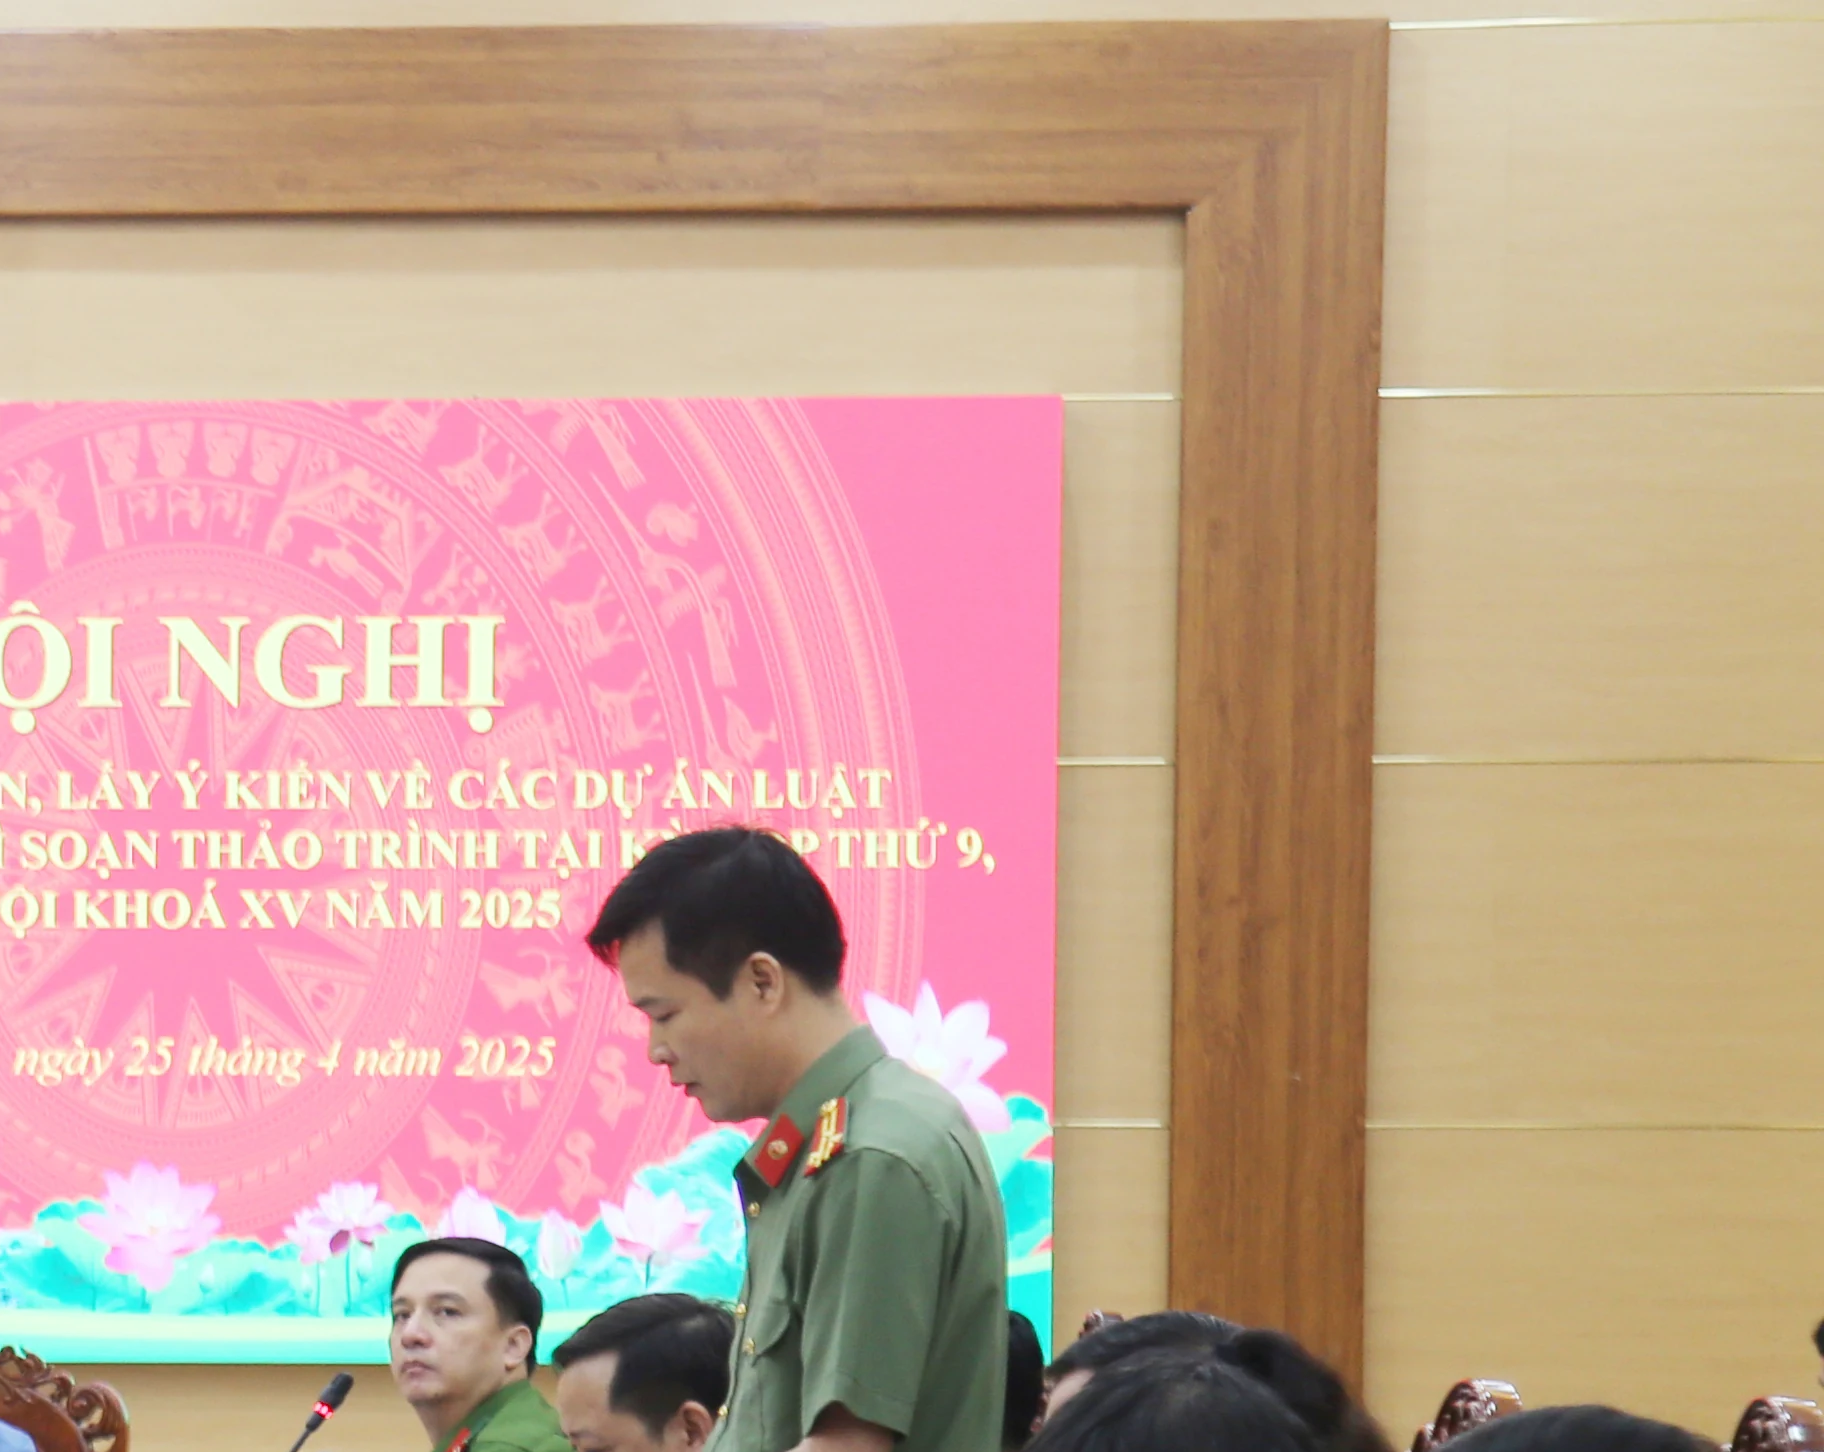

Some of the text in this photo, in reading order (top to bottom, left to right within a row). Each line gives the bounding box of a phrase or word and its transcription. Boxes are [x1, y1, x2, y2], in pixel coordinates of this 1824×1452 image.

[158, 613, 506, 734] NGHỊ
[56, 760, 161, 811] LẤY
[173, 759, 209, 810] Ý
[225, 759, 352, 810] KIẾN
[365, 759, 434, 810] VỀ
[447, 758, 558, 811] CÁC
[573, 764, 654, 820] DỰ
[664, 758, 735, 810] ÁN
[753, 762, 893, 819] LUẬT
[19, 829, 158, 880] SOẠN
[172, 819, 323, 870] THẢO
[334, 818, 499, 870] TRÌNH
[513, 829, 602, 880] TẠI
[829, 818, 948, 870] THỨ
[956, 828, 996, 874] 9,
[73, 876, 227, 930] KHOÁ
[239, 889, 313, 930] XV
[324, 879, 443, 930] NĂM
[460, 887, 562, 930] 2025
[12, 1036, 115, 1087] ngày
[124, 1035, 176, 1078] 25
[187, 1035, 307, 1087] tháng
[316, 1036, 343, 1078] 4
[352, 1036, 443, 1078] năm
[453, 1034, 558, 1079] 2025
